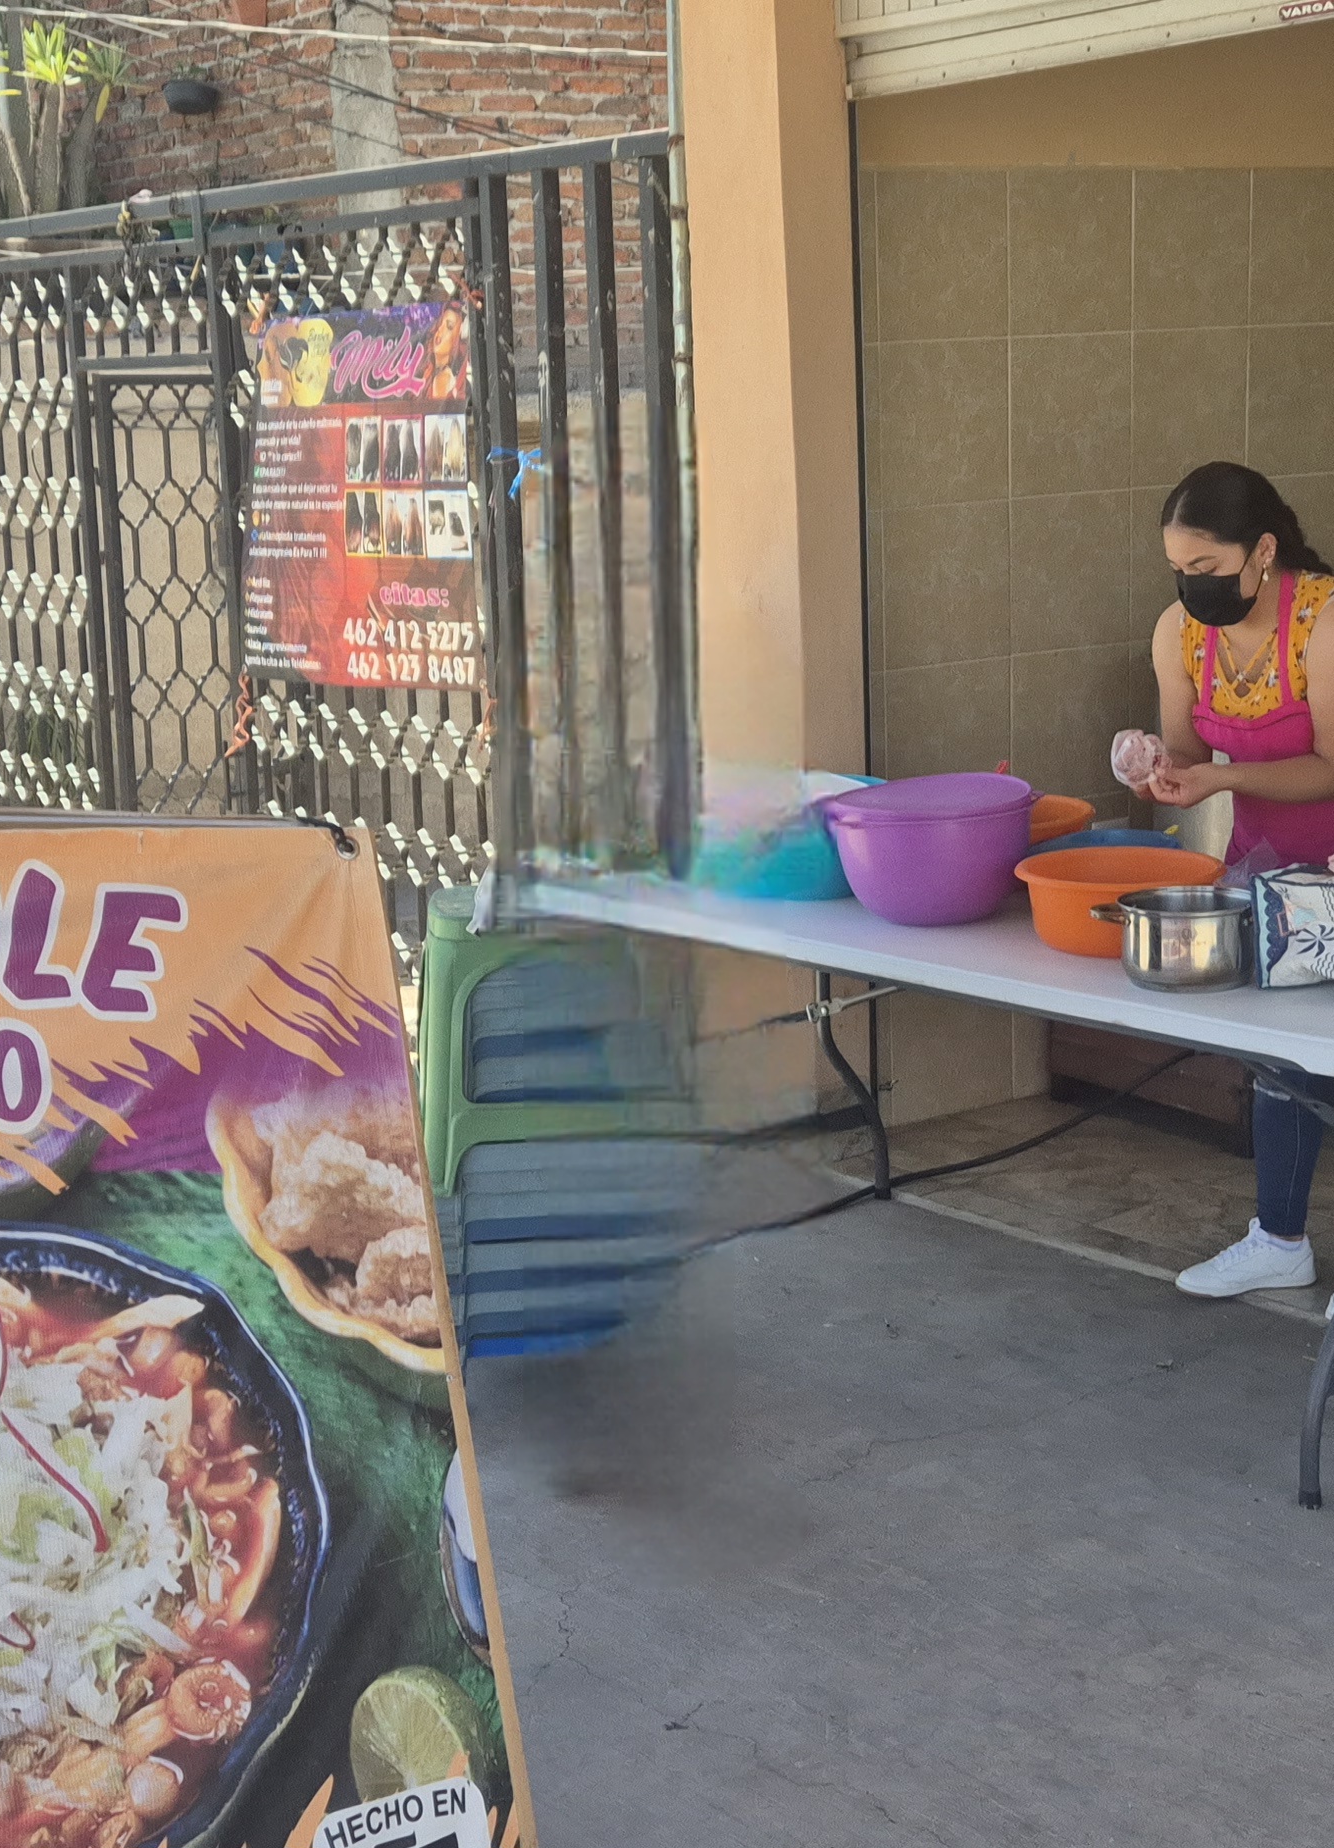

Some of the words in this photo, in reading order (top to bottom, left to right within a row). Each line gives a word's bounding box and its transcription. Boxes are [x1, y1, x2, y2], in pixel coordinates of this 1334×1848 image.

[379, 581, 450, 608] citas:
[343, 617, 378, 647] 462
[384, 619, 423, 650] 412
[426, 620, 474, 651] 5275
[347, 651, 382, 680] 462
[386, 652, 421, 682] 123
[427, 654, 475, 685] 8487
[324, 1794, 424, 1848] HECHO
[432, 1787, 466, 1817] EN
